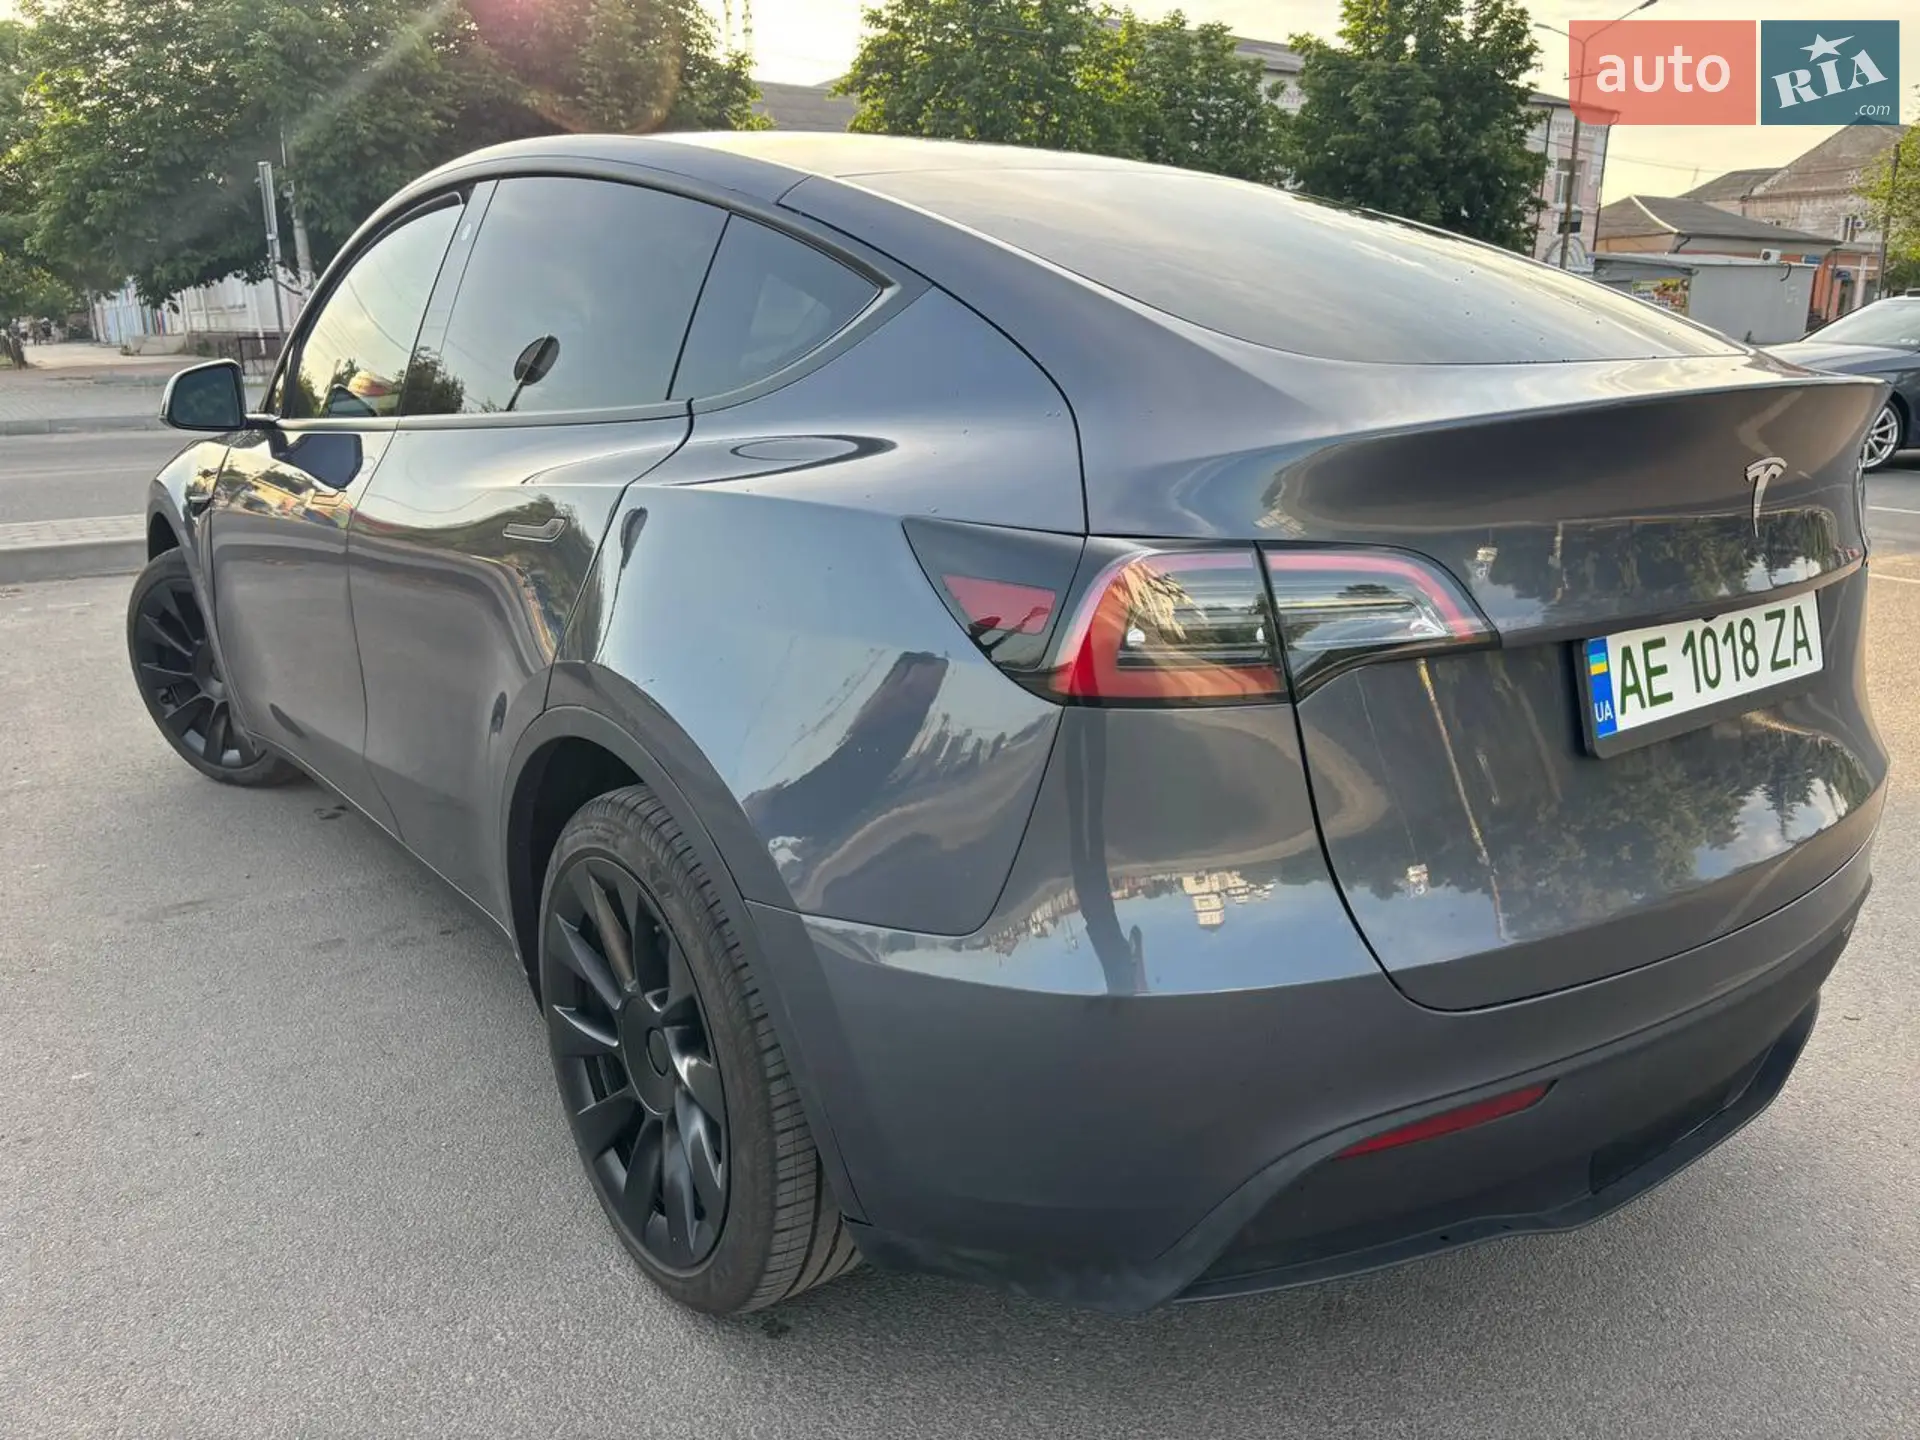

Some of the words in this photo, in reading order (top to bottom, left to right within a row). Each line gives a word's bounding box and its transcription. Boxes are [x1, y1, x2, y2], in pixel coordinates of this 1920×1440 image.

[1620, 637, 1673, 715] AE
[1681, 617, 1759, 694] 1018
[1764, 605, 1813, 672] ZA
[1594, 703, 1613, 723] UA
